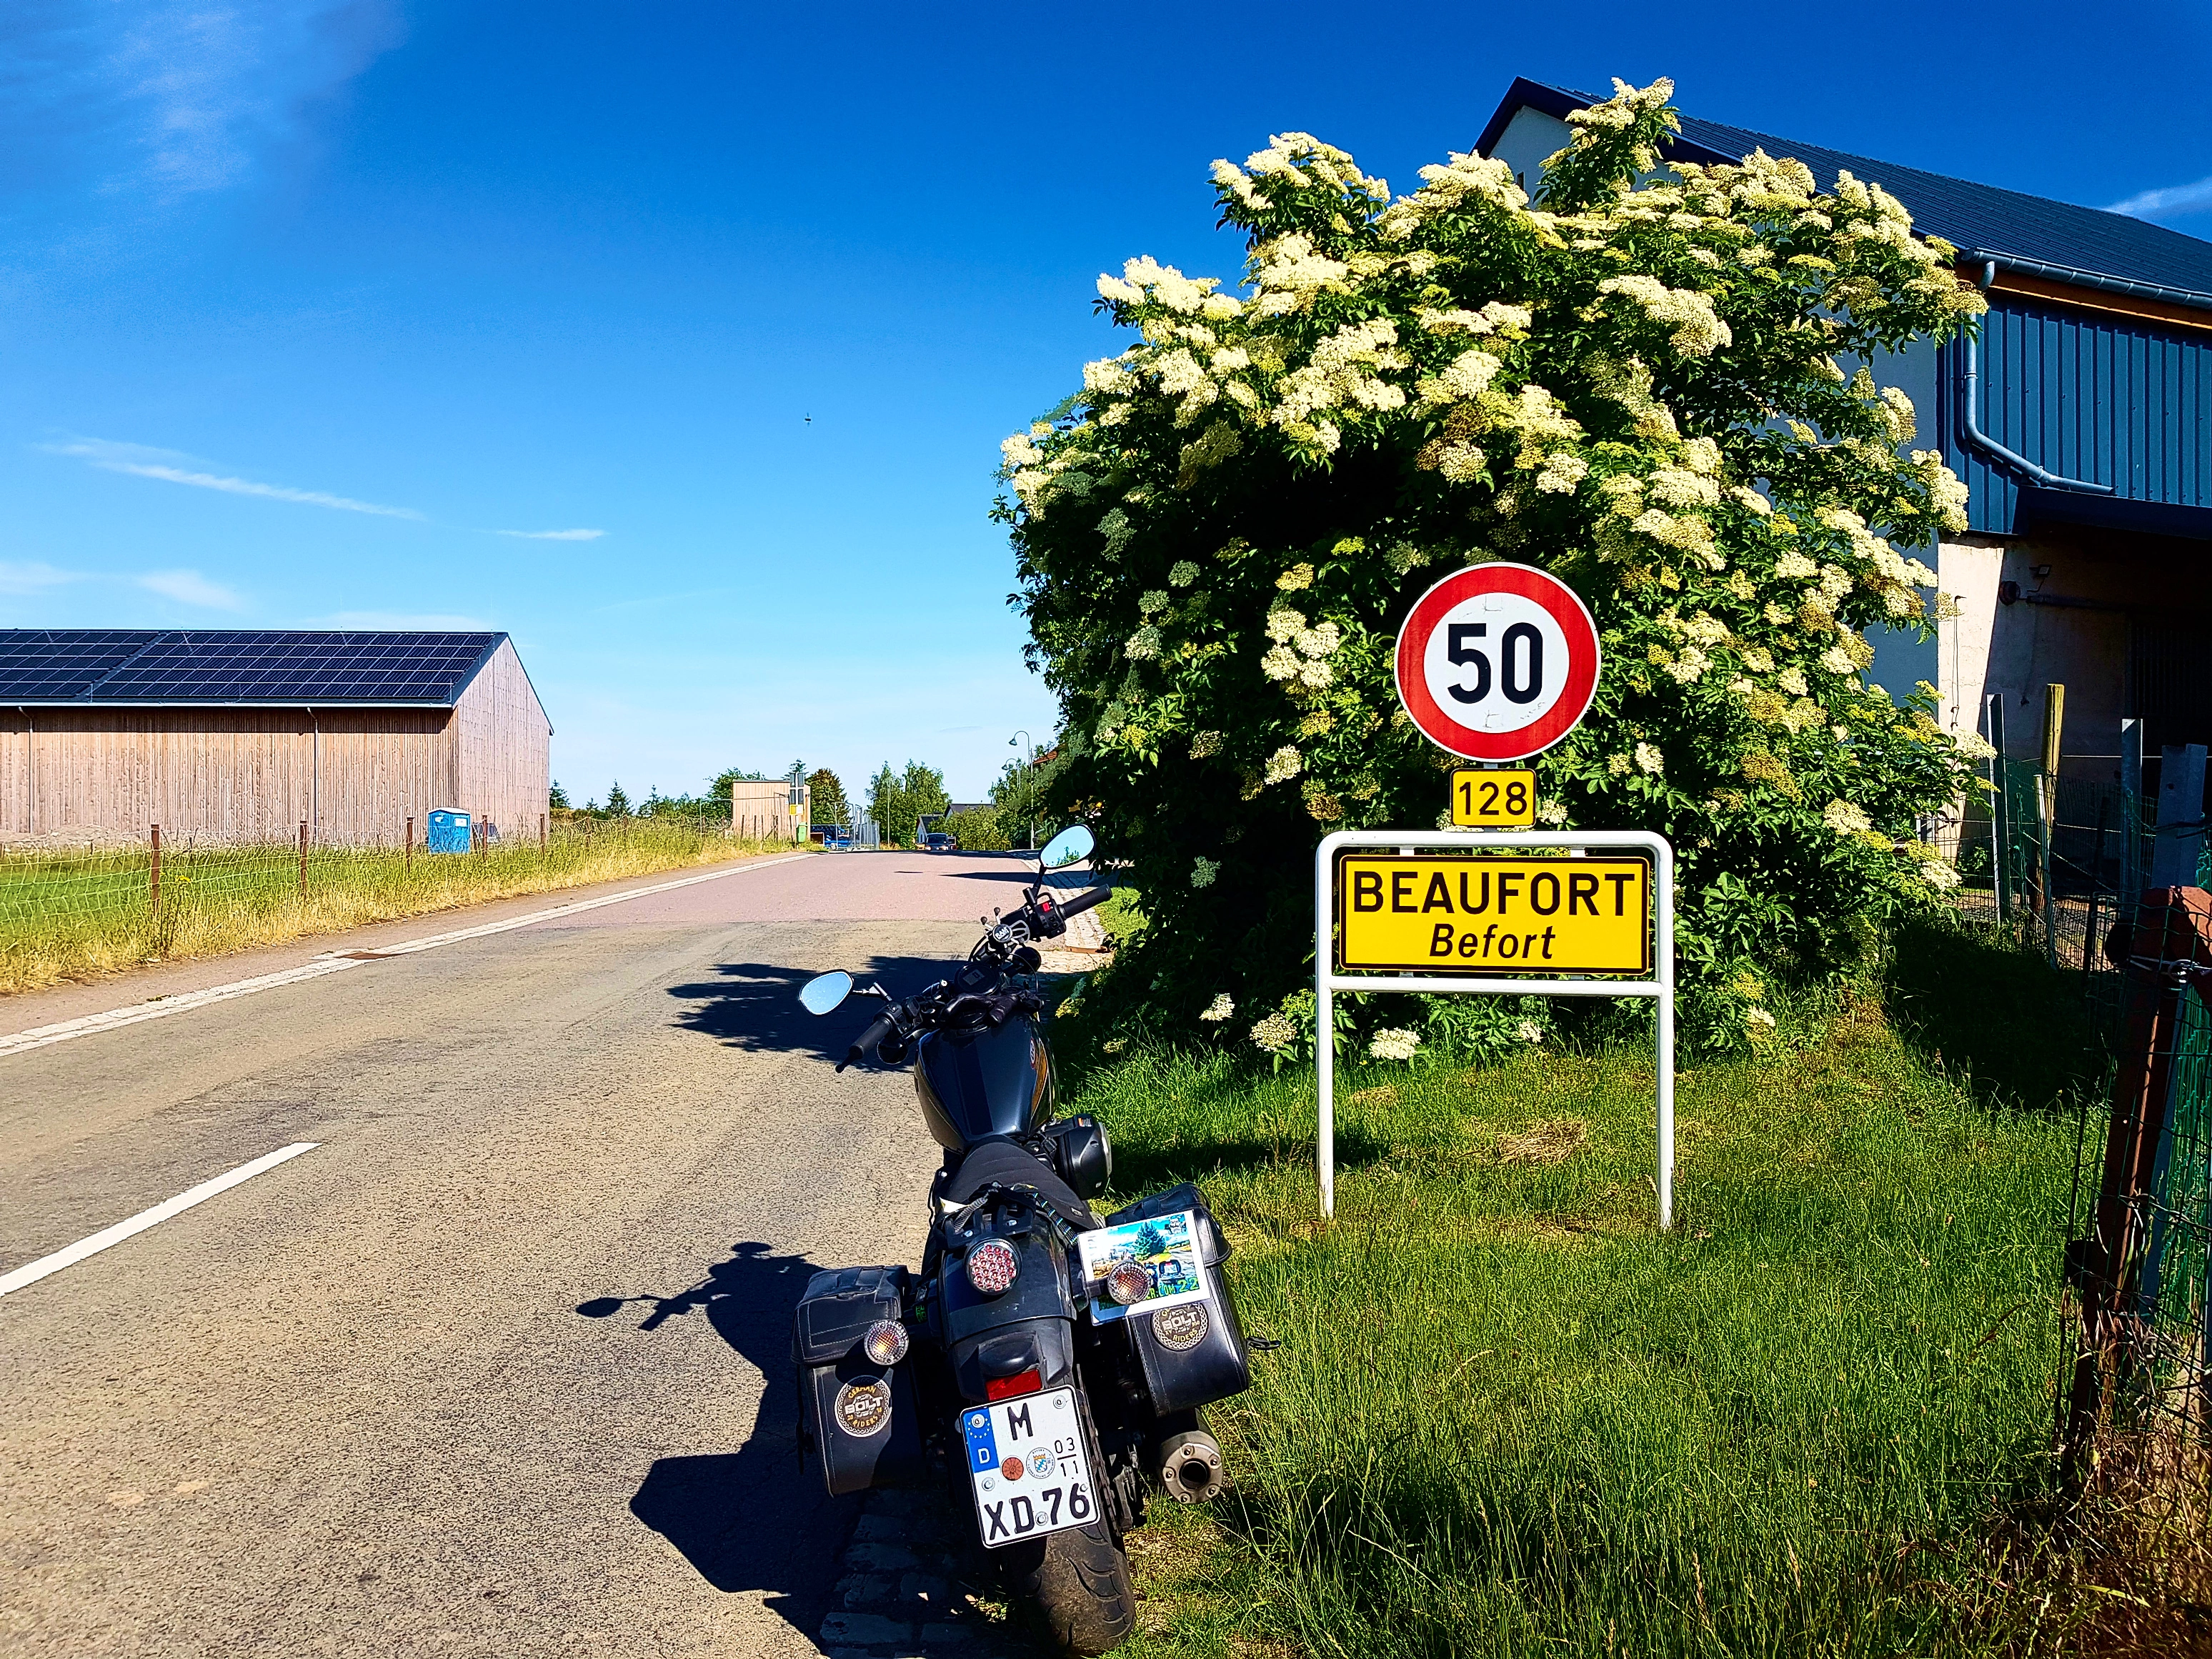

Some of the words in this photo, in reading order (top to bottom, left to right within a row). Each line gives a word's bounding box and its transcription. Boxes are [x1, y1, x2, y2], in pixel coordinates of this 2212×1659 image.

[1447, 622, 1543, 704] 50
[1458, 781, 1528, 817] 128
[1353, 870, 1636, 917] BEAUFORT
[1429, 923, 1556, 960] Befort
[1161, 1311, 1197, 1330] BOLT
[1172, 1328, 1197, 1342] RIDERS
[845, 1396, 884, 1415] BOLT
[852, 1415, 878, 1428] RIDERS
[1007, 1402, 1034, 1441] M
[1054, 1437, 1076, 1454] 03
[977, 1448, 991, 1464] D
[1060, 1460, 1079, 1477] 11
